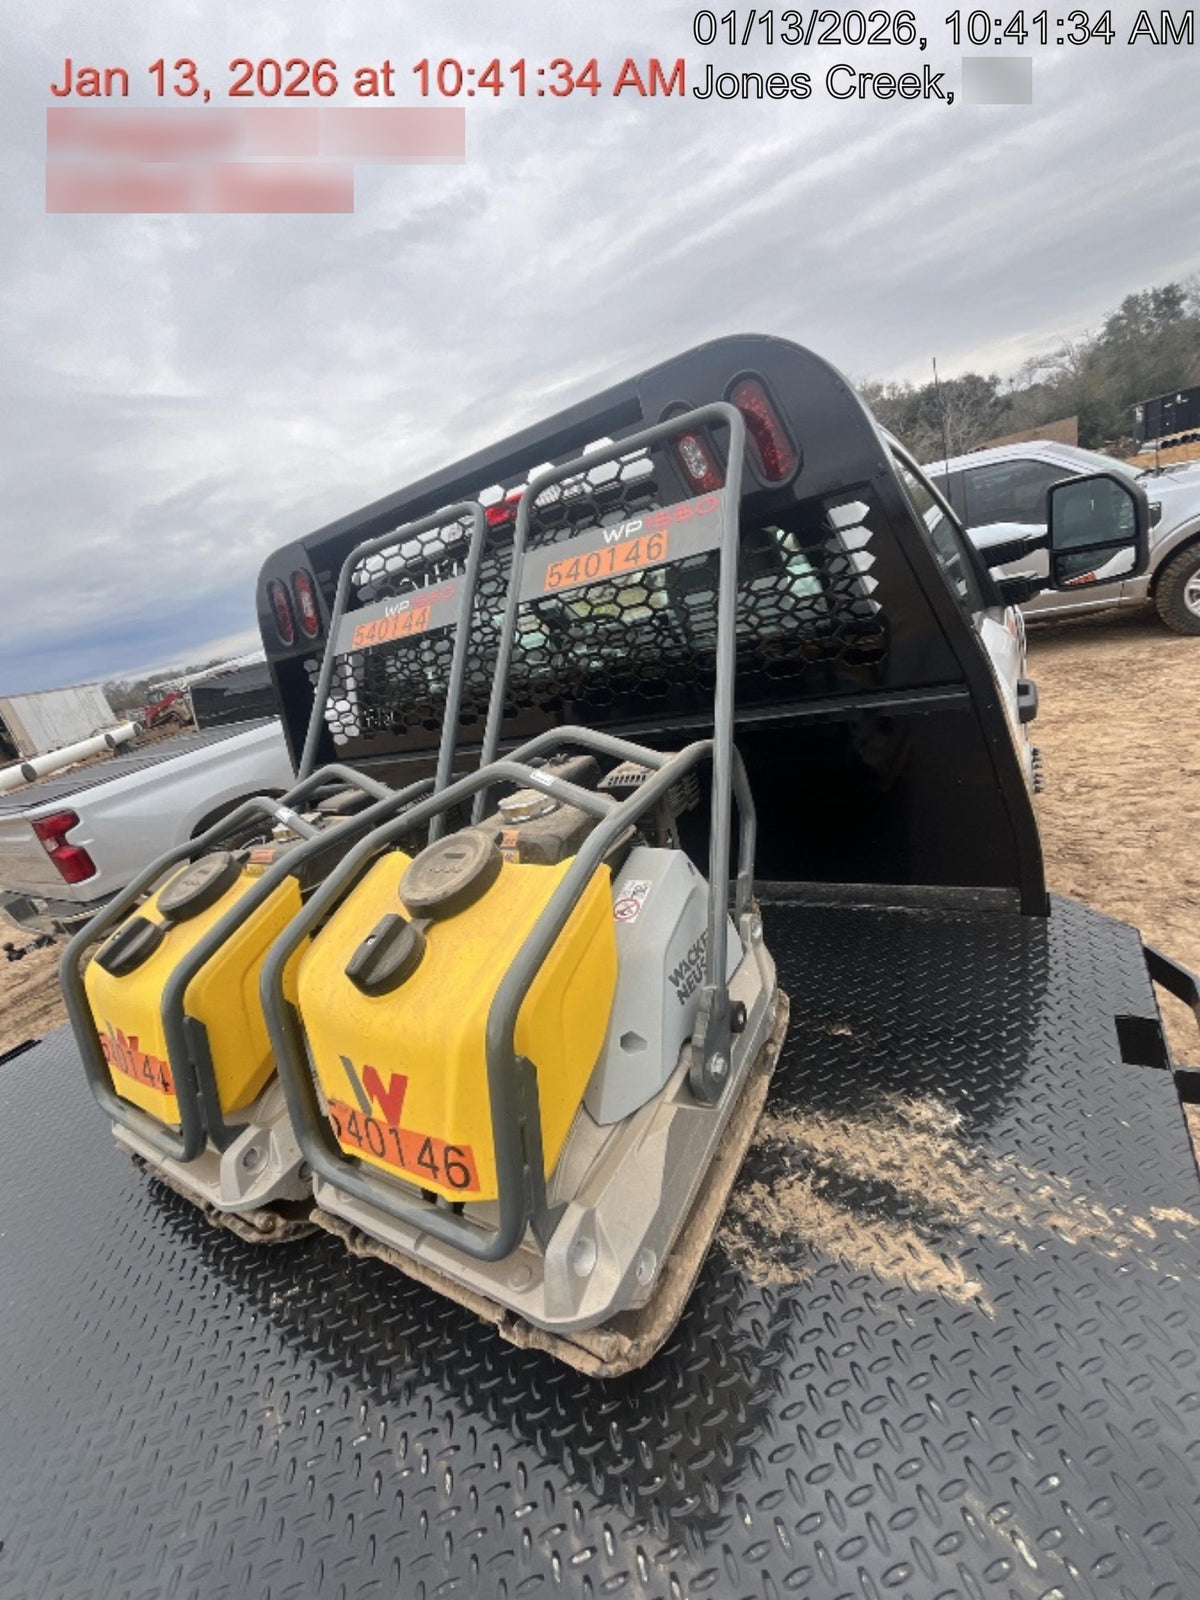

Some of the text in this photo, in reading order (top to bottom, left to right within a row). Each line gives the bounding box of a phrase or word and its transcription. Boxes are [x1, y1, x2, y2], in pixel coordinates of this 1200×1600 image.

[542, 532, 664, 590] 540146
[354, 606, 427, 646] 540144
[668, 927, 708, 987] WACK
